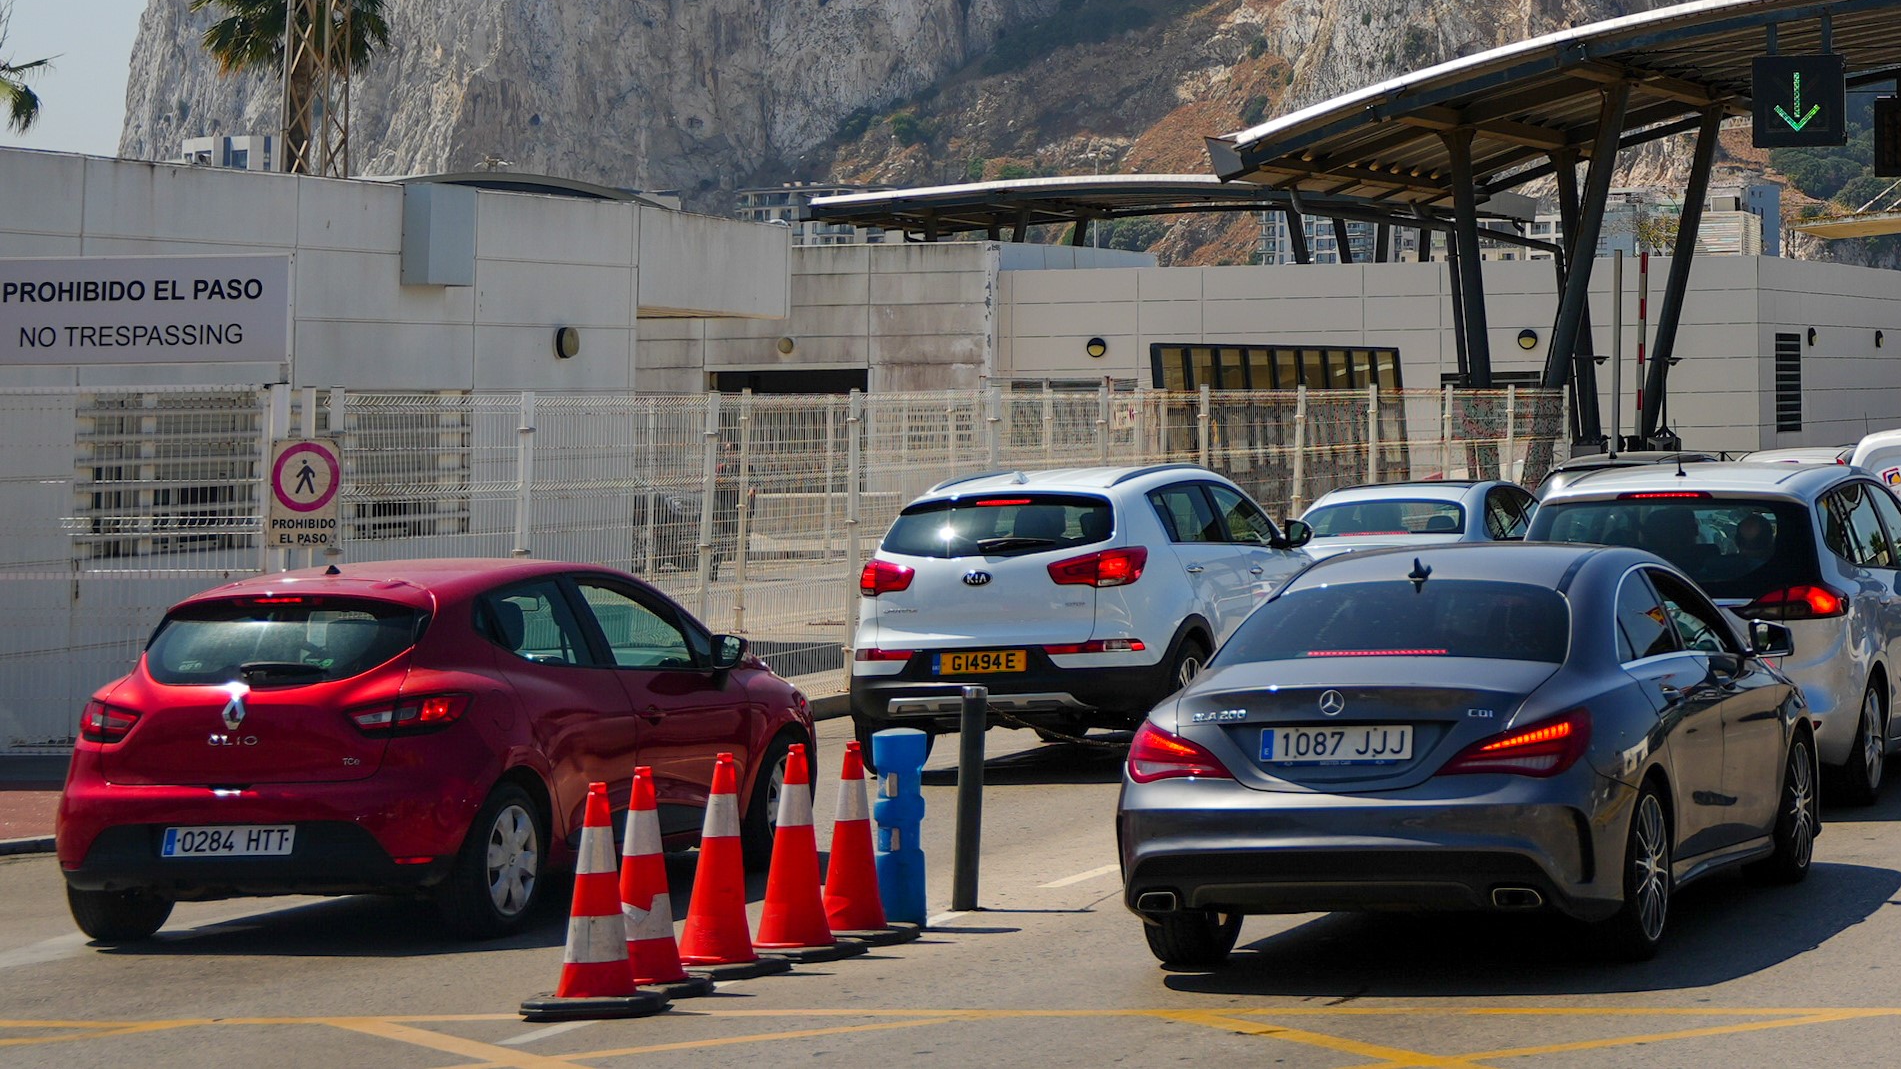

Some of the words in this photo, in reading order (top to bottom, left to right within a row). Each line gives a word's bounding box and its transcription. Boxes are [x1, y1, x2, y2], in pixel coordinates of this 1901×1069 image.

[2, 280, 146, 303] PROHIBIDO
[153, 279, 186, 302] EL
[193, 278, 264, 301] PASO
[19, 326, 57, 348] NO
[64, 323, 244, 347] TRESPASSING
[272, 518, 337, 529] PROHIBIDO
[279, 533, 294, 544] EL
[297, 533, 327, 544] PASO
[966, 573, 988, 584] KIA
[1219, 709, 1248, 721] 200
[208, 733, 258, 746] CLIO
[1282, 731, 1345, 757] 1087
[1355, 730, 1405, 755] JJJ
[342, 757, 360, 766] TCe
[181, 829, 234, 853] 0284
[246, 829, 289, 852] HTT
